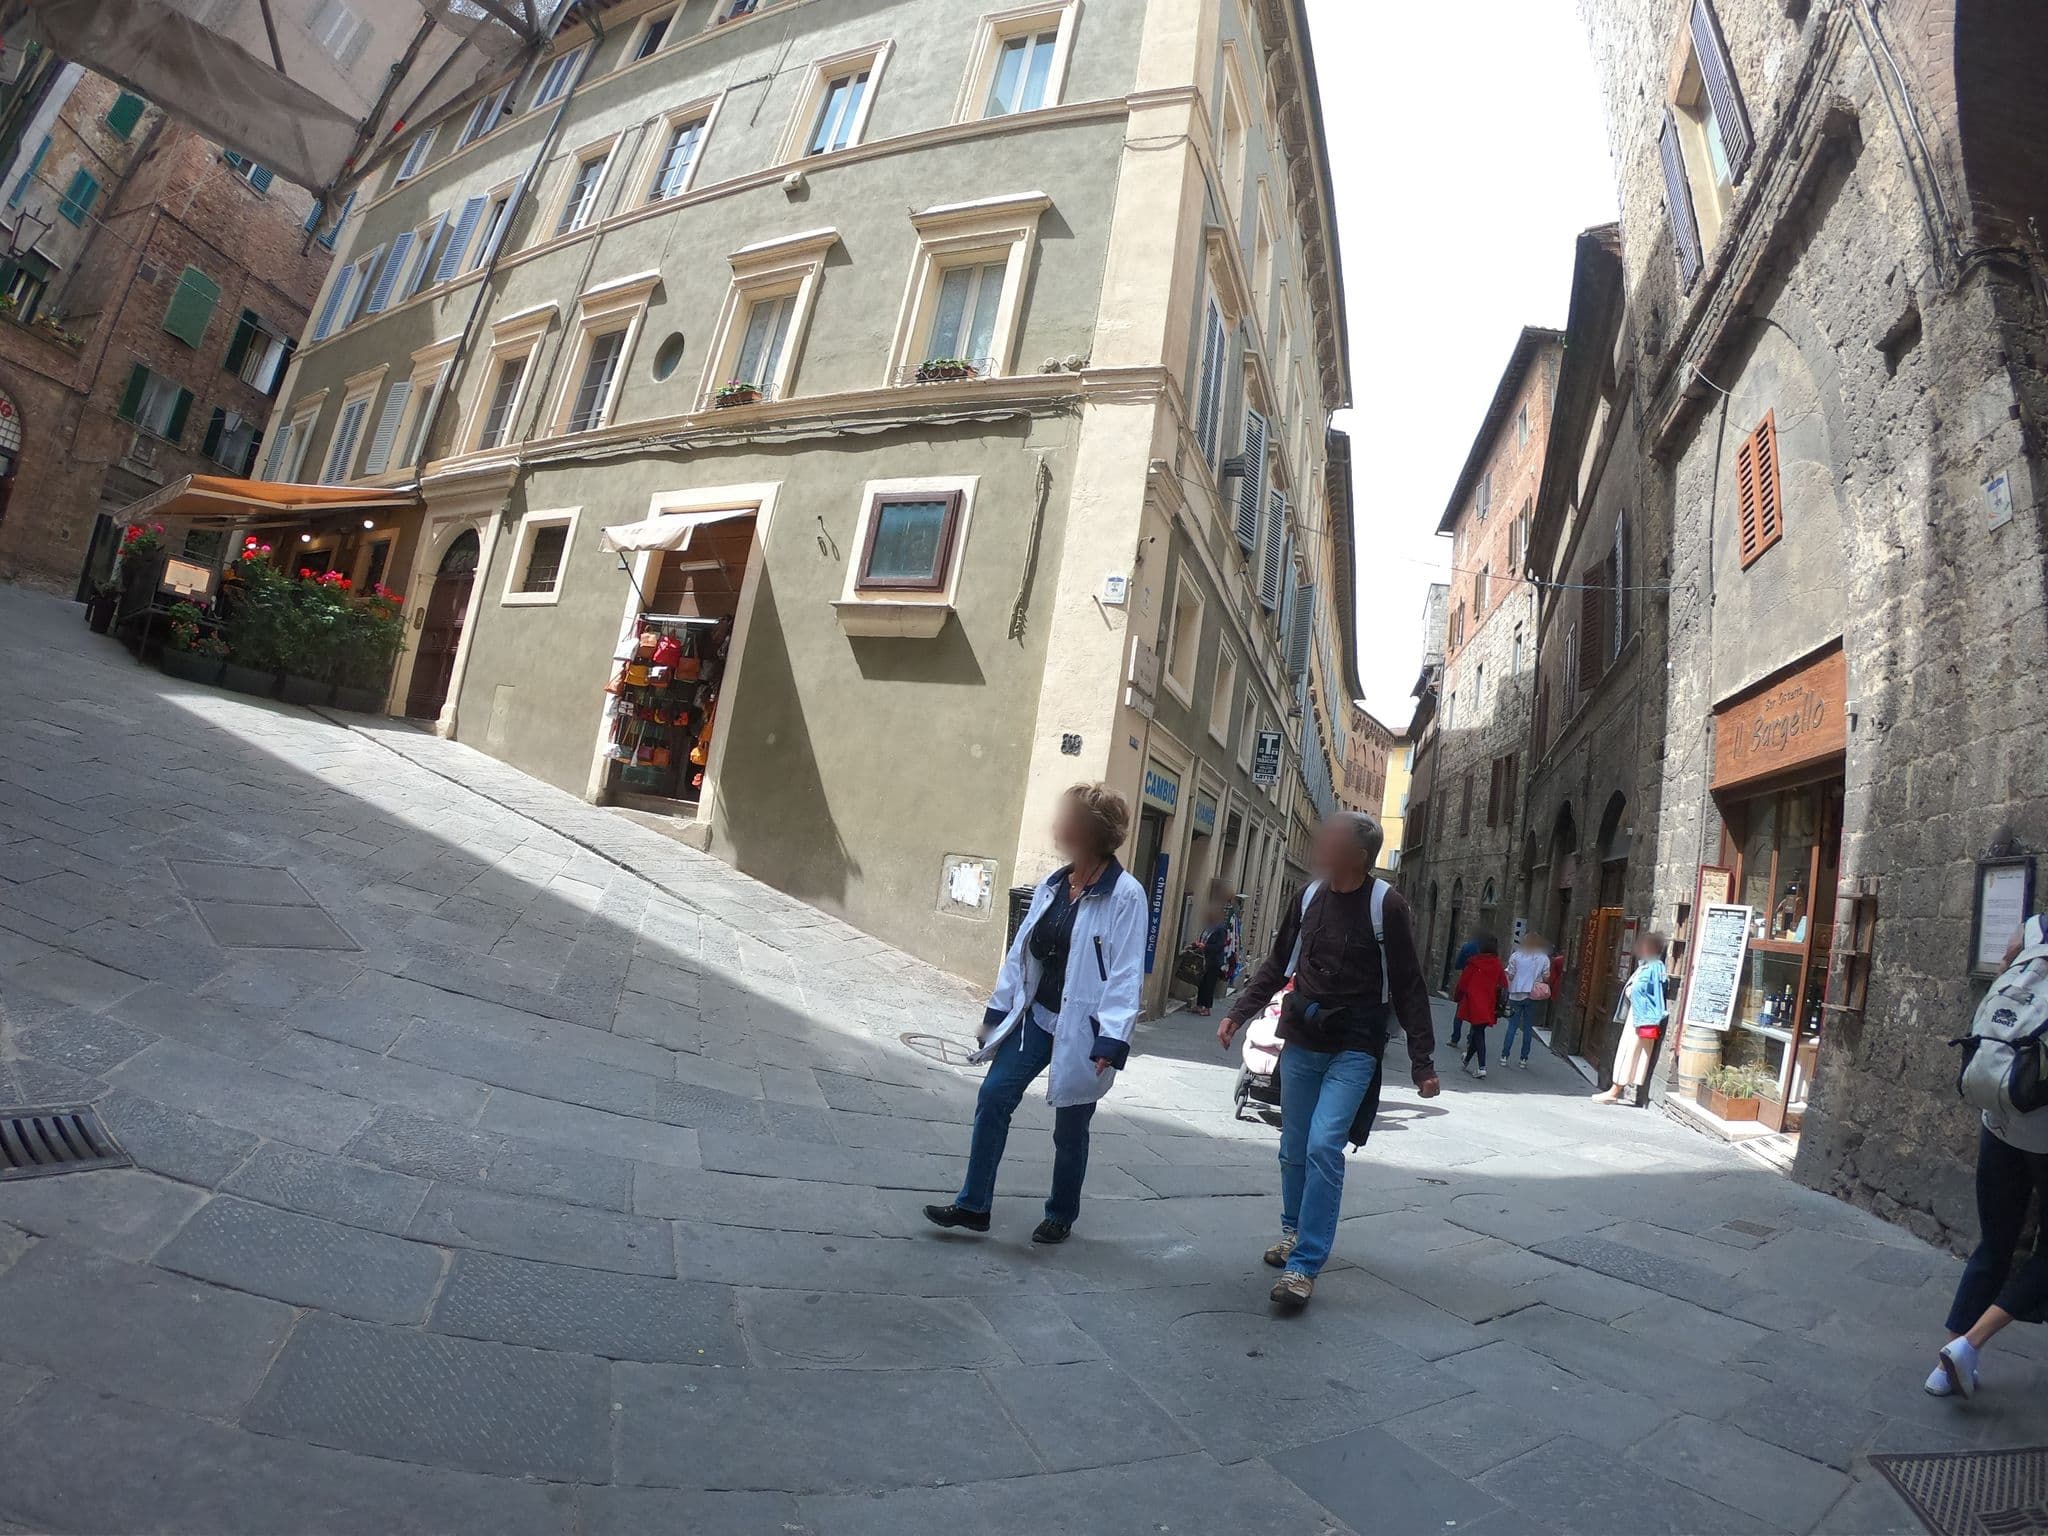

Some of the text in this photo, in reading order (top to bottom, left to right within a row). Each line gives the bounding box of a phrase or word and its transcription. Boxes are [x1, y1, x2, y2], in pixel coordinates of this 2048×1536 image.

[1750, 691, 1825, 752] Bargello
[1262, 734, 1278, 754] T
[1144, 770, 1176, 805] CAMBIO
[1153, 877, 1166, 913] change
[1991, 1014, 2014, 1028] Roots
